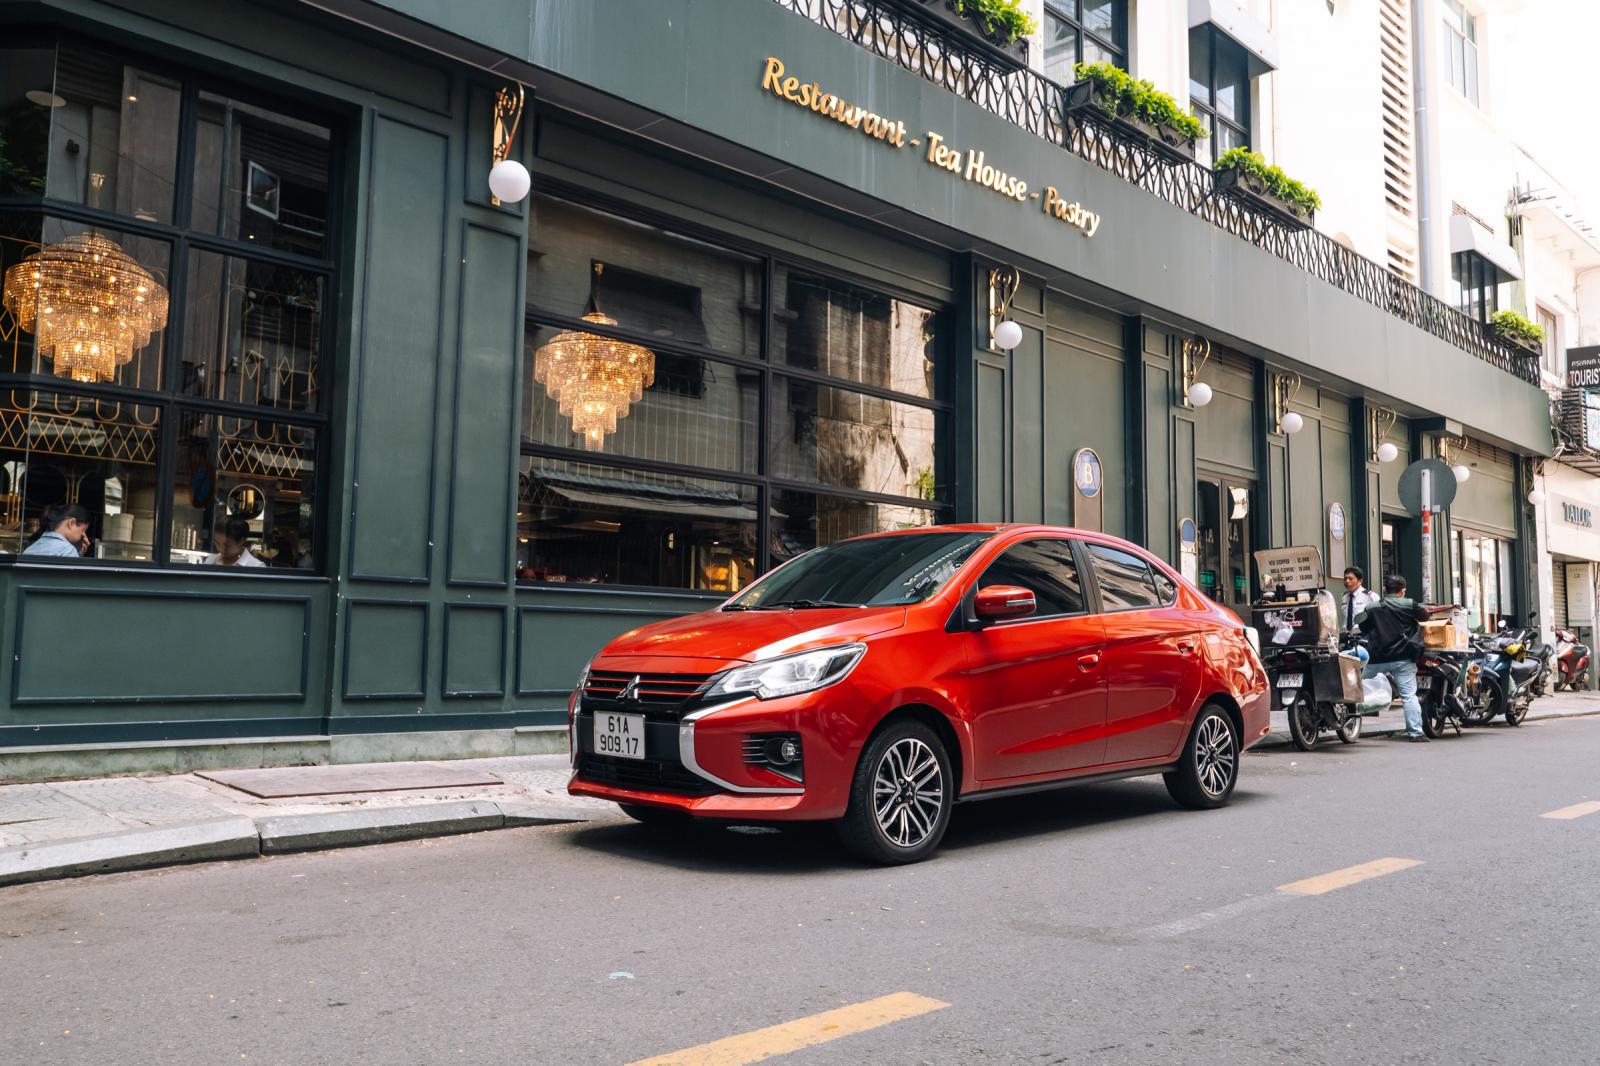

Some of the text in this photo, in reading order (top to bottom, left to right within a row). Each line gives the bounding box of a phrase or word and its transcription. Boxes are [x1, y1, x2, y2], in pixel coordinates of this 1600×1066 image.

[761, 56, 907, 148] Restaurant
[927, 131, 962, 173] Tea
[965, 149, 1028, 201] House
[1043, 185, 1100, 237] Pastry
[1561, 501, 1593, 528] TAILOR
[608, 715, 629, 734] 61A
[600, 734, 639, 754] 909.17
